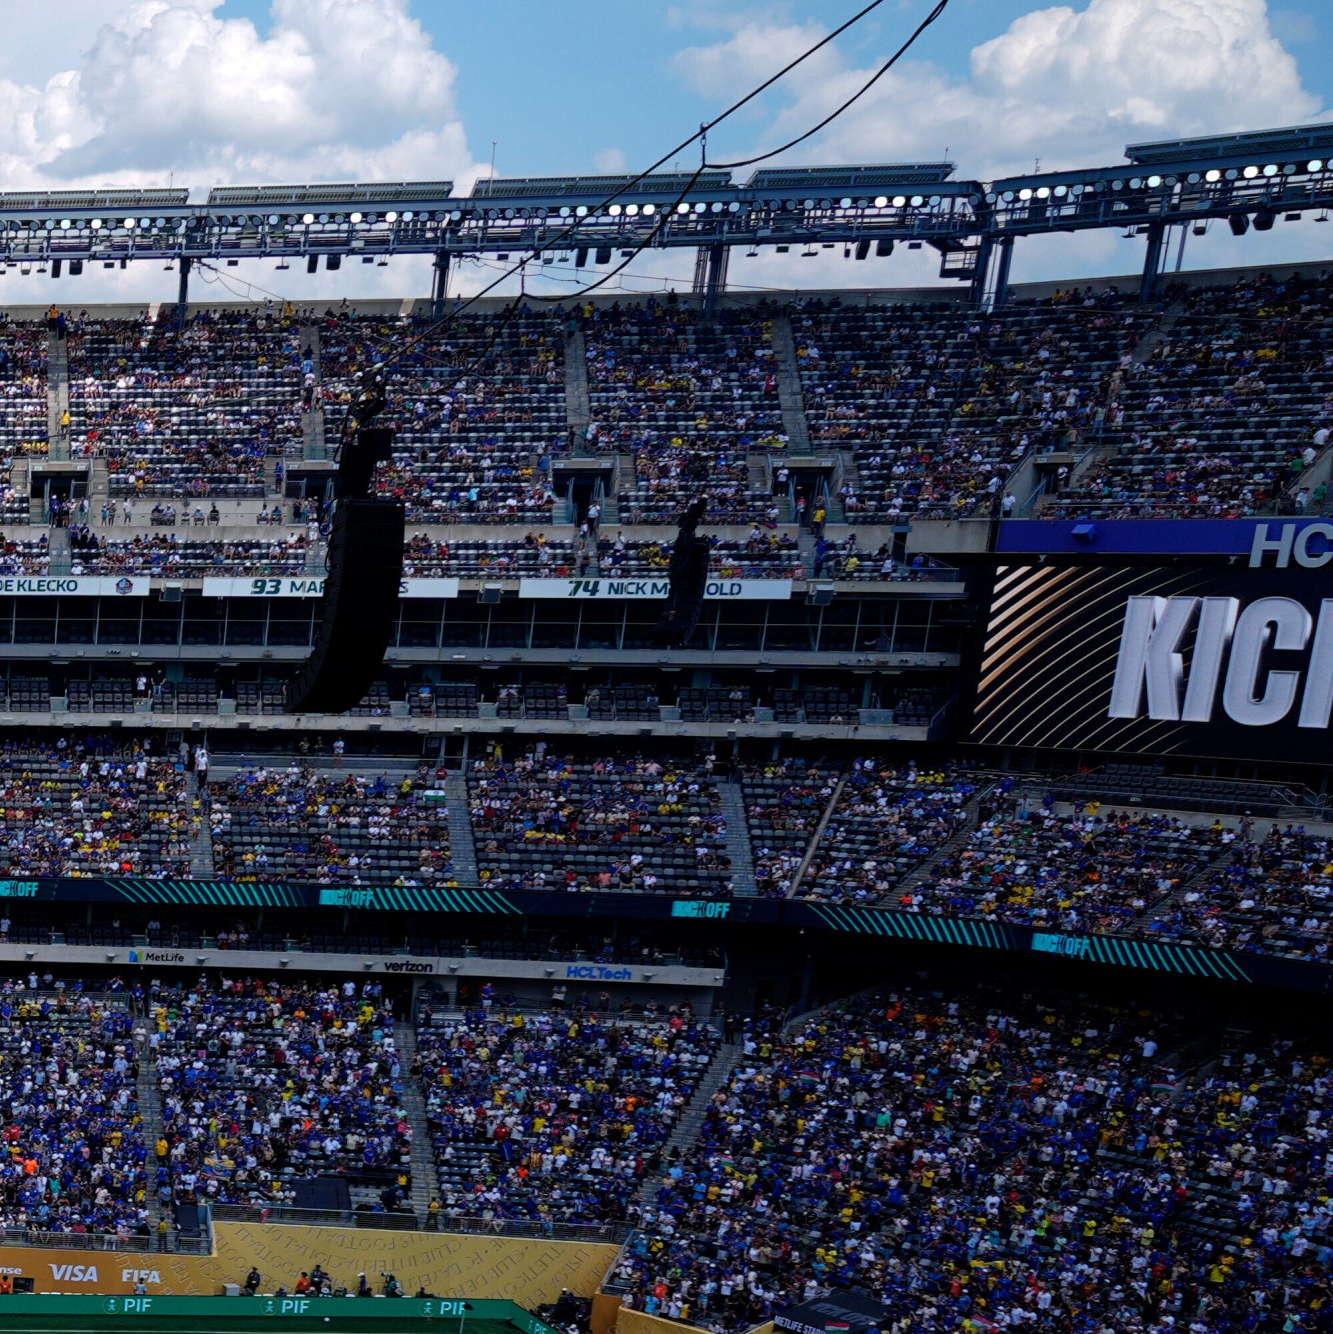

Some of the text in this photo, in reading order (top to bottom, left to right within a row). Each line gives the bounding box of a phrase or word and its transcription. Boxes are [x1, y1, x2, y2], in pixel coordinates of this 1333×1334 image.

[16, 579, 78, 593] KLECKO
[250, 579, 282, 595] 93
[568, 580, 601, 597] 74
[607, 582, 646, 596] NICK
[1066, 935, 1090, 957] OFF
[145, 953, 185, 963] MetLife
[384, 960, 433, 973] verizon
[566, 965, 633, 980] HCLTech
[49, 1263, 99, 1283] VISA
[121, 1266, 161, 1284] FIFA
[124, 1298, 152, 1312] PIF
[282, 1299, 311, 1314] PIF
[440, 1301, 466, 1315] PIF
[774, 1314, 803, 1333] METLIFE
